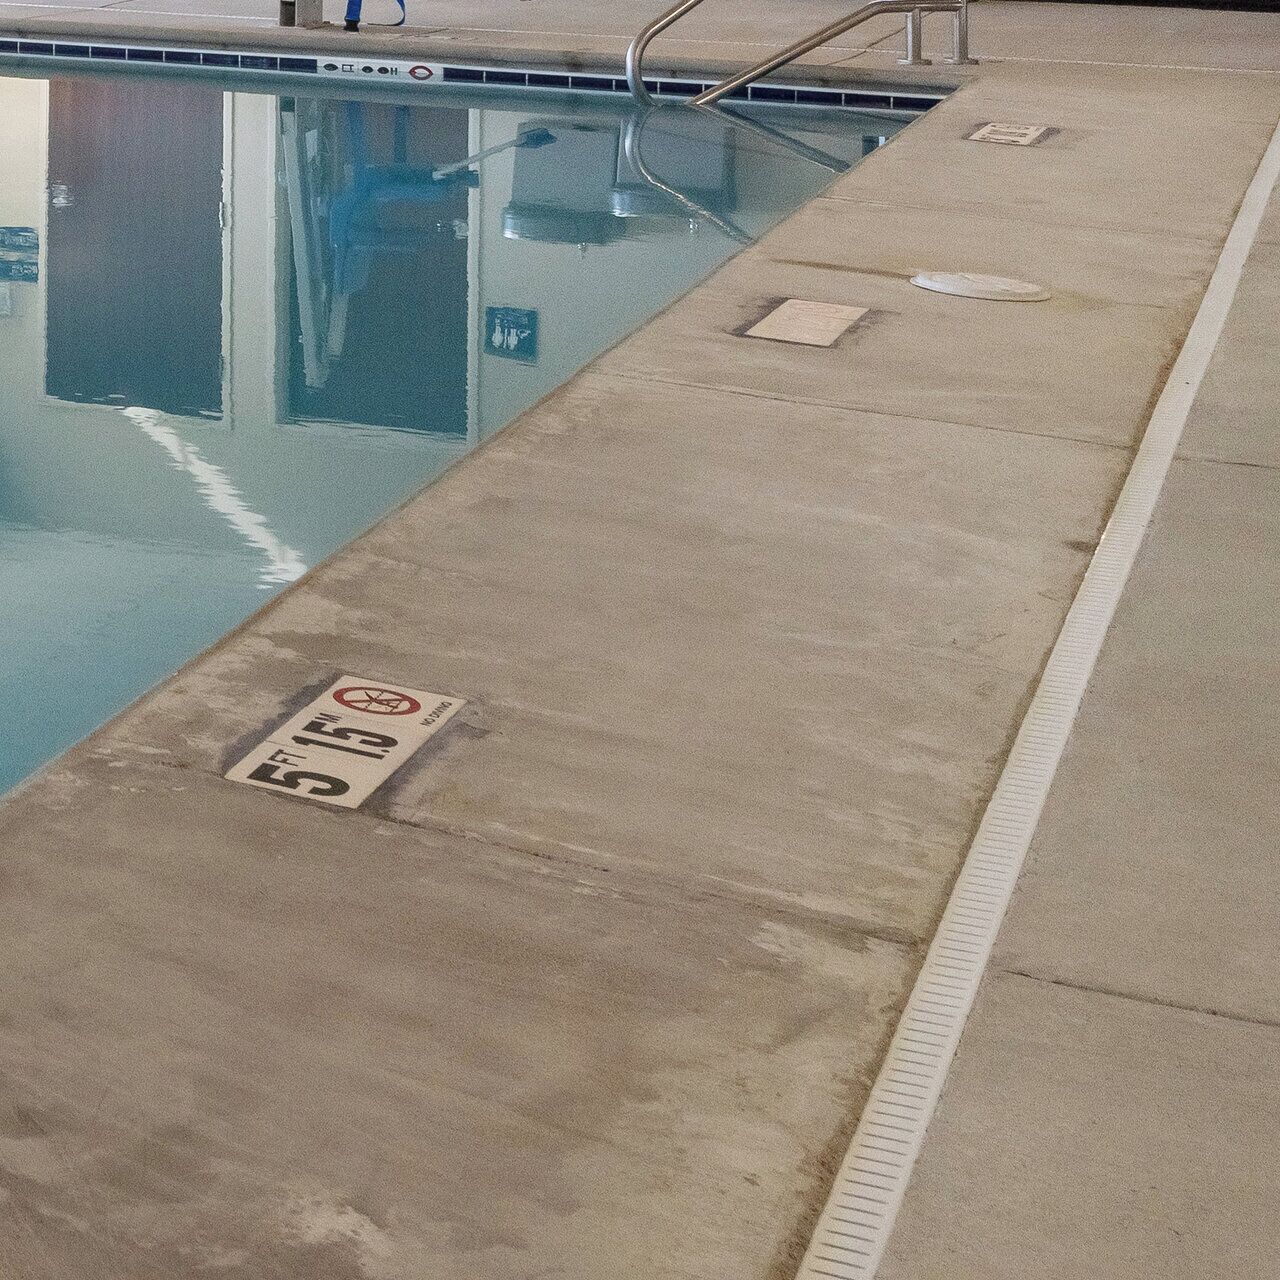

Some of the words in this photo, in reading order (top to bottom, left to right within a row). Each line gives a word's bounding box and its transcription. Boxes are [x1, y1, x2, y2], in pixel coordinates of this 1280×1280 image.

[315, 712, 343, 724] M
[419, 717, 436, 727] NO
[428, 701, 453, 719] DIVING
[291, 720, 398, 760] 1.5
[267, 749, 307, 767] FT
[247, 763, 350, 797] 5
